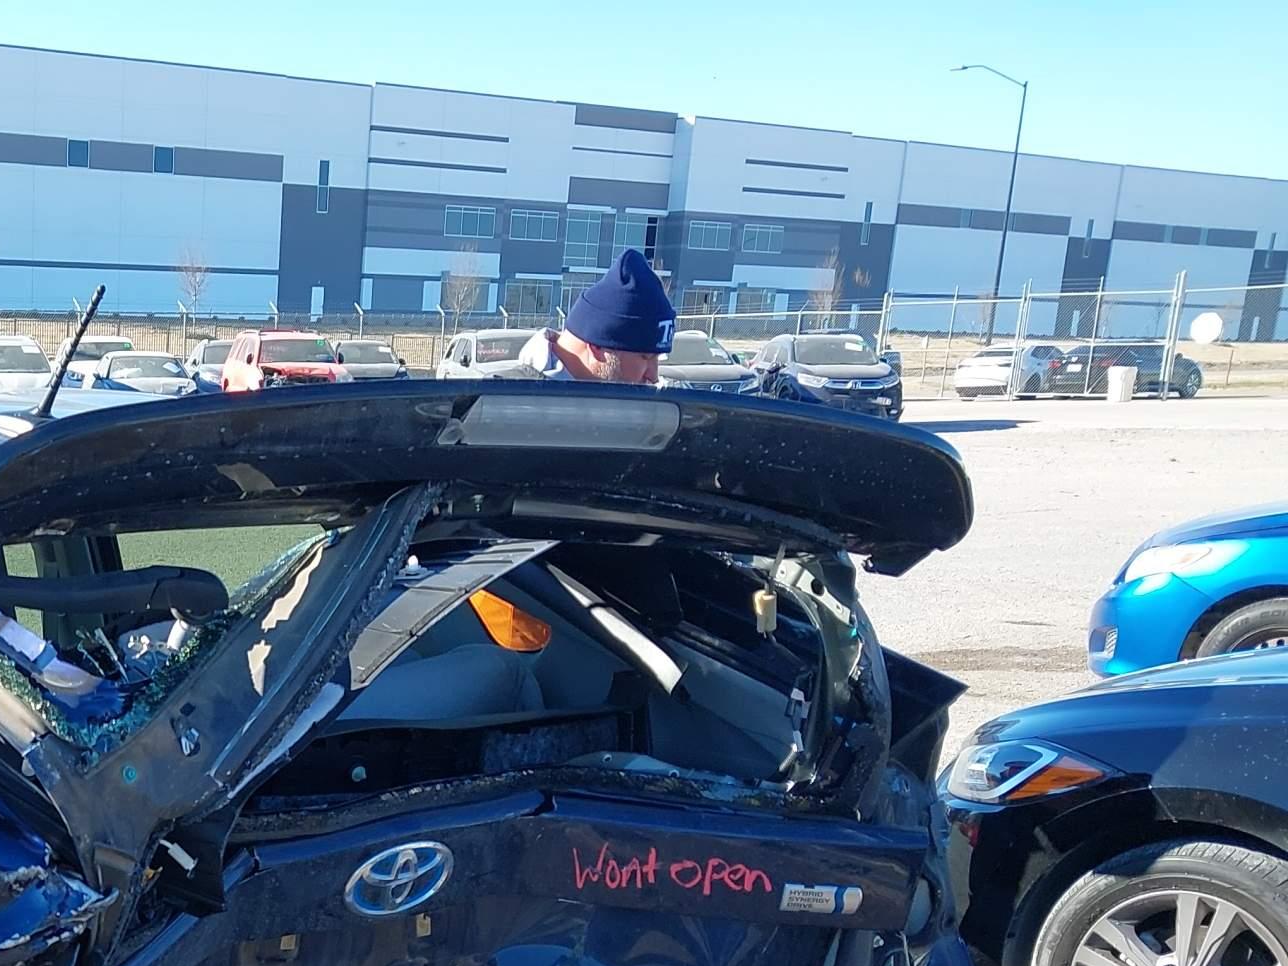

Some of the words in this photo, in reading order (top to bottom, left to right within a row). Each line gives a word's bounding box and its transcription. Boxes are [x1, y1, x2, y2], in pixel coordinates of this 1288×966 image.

[573, 842, 657, 889] Wont
[670, 858, 772, 896] open
[788, 896, 831, 904] SYNERGY
